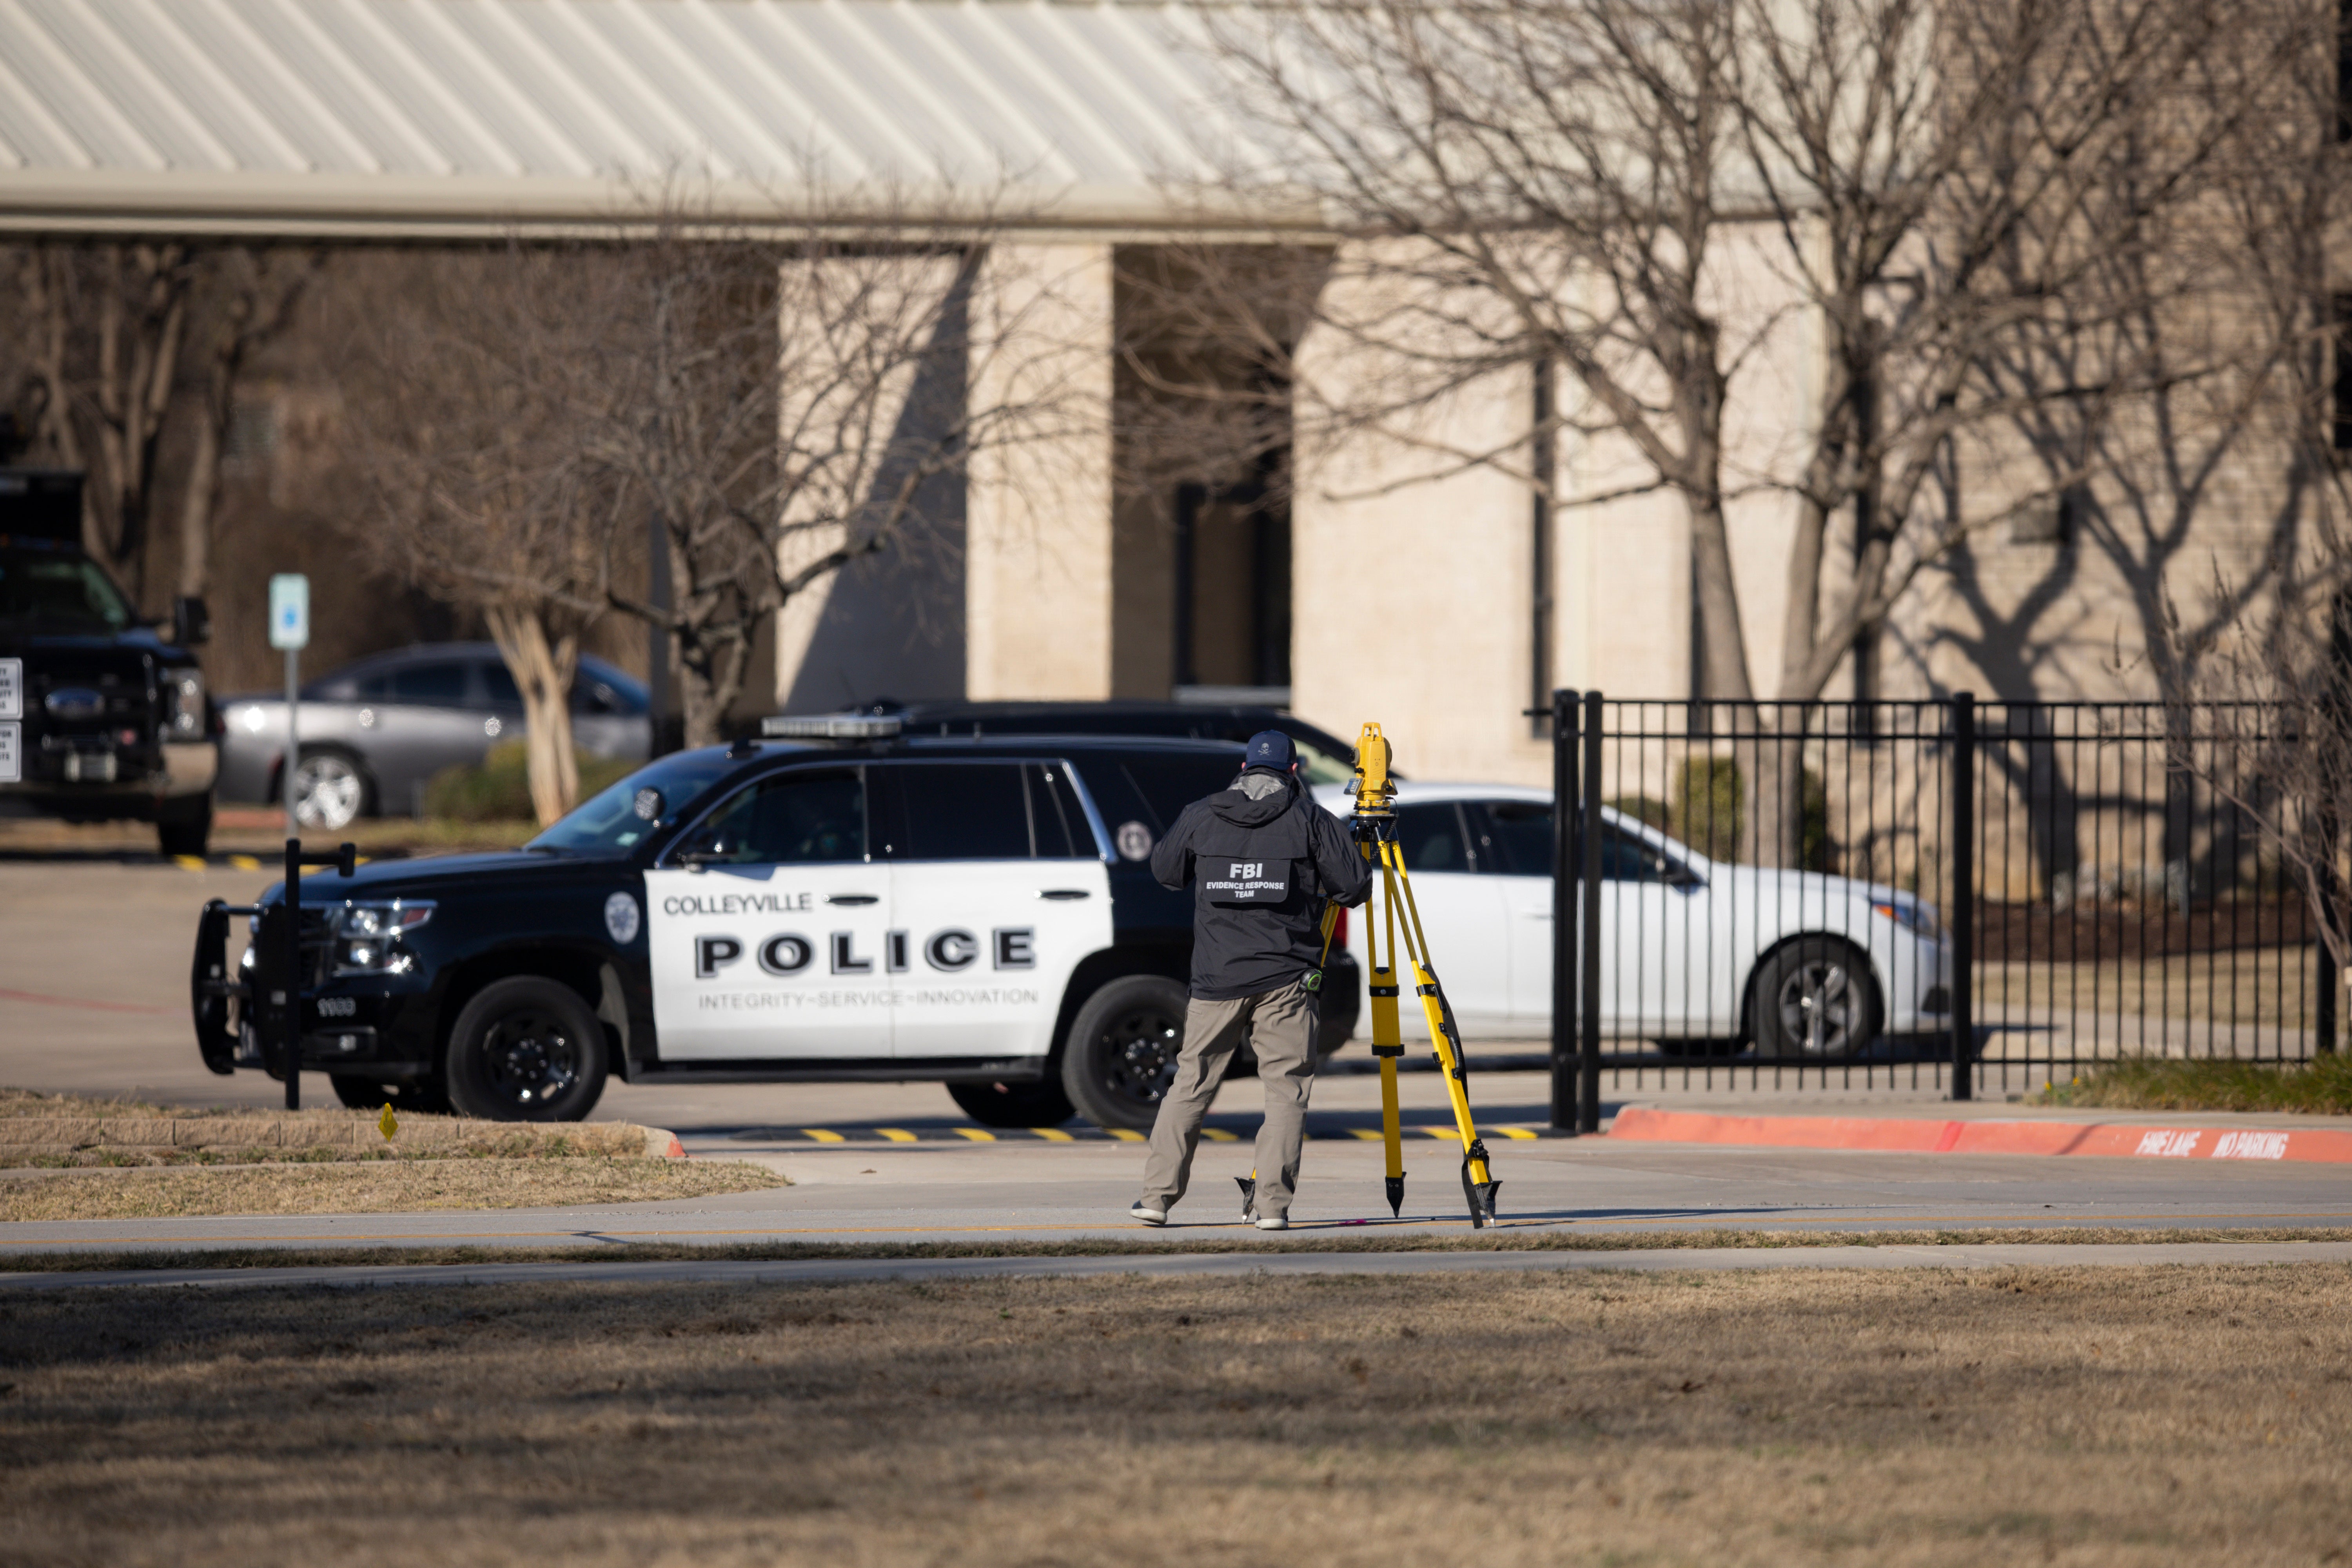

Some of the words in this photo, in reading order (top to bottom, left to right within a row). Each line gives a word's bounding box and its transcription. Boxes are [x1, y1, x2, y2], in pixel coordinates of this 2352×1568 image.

[1229, 863, 1263, 879] FBI
[663, 892, 813, 916] COLLEYVILLE
[694, 926, 1037, 979] POLICE
[2134, 1130, 2171, 1156] FIRE
[2162, 1131, 2202, 1157] LANE
[2210, 1131, 2240, 1158] NO
[2230, 1131, 2290, 1160] PARKING
